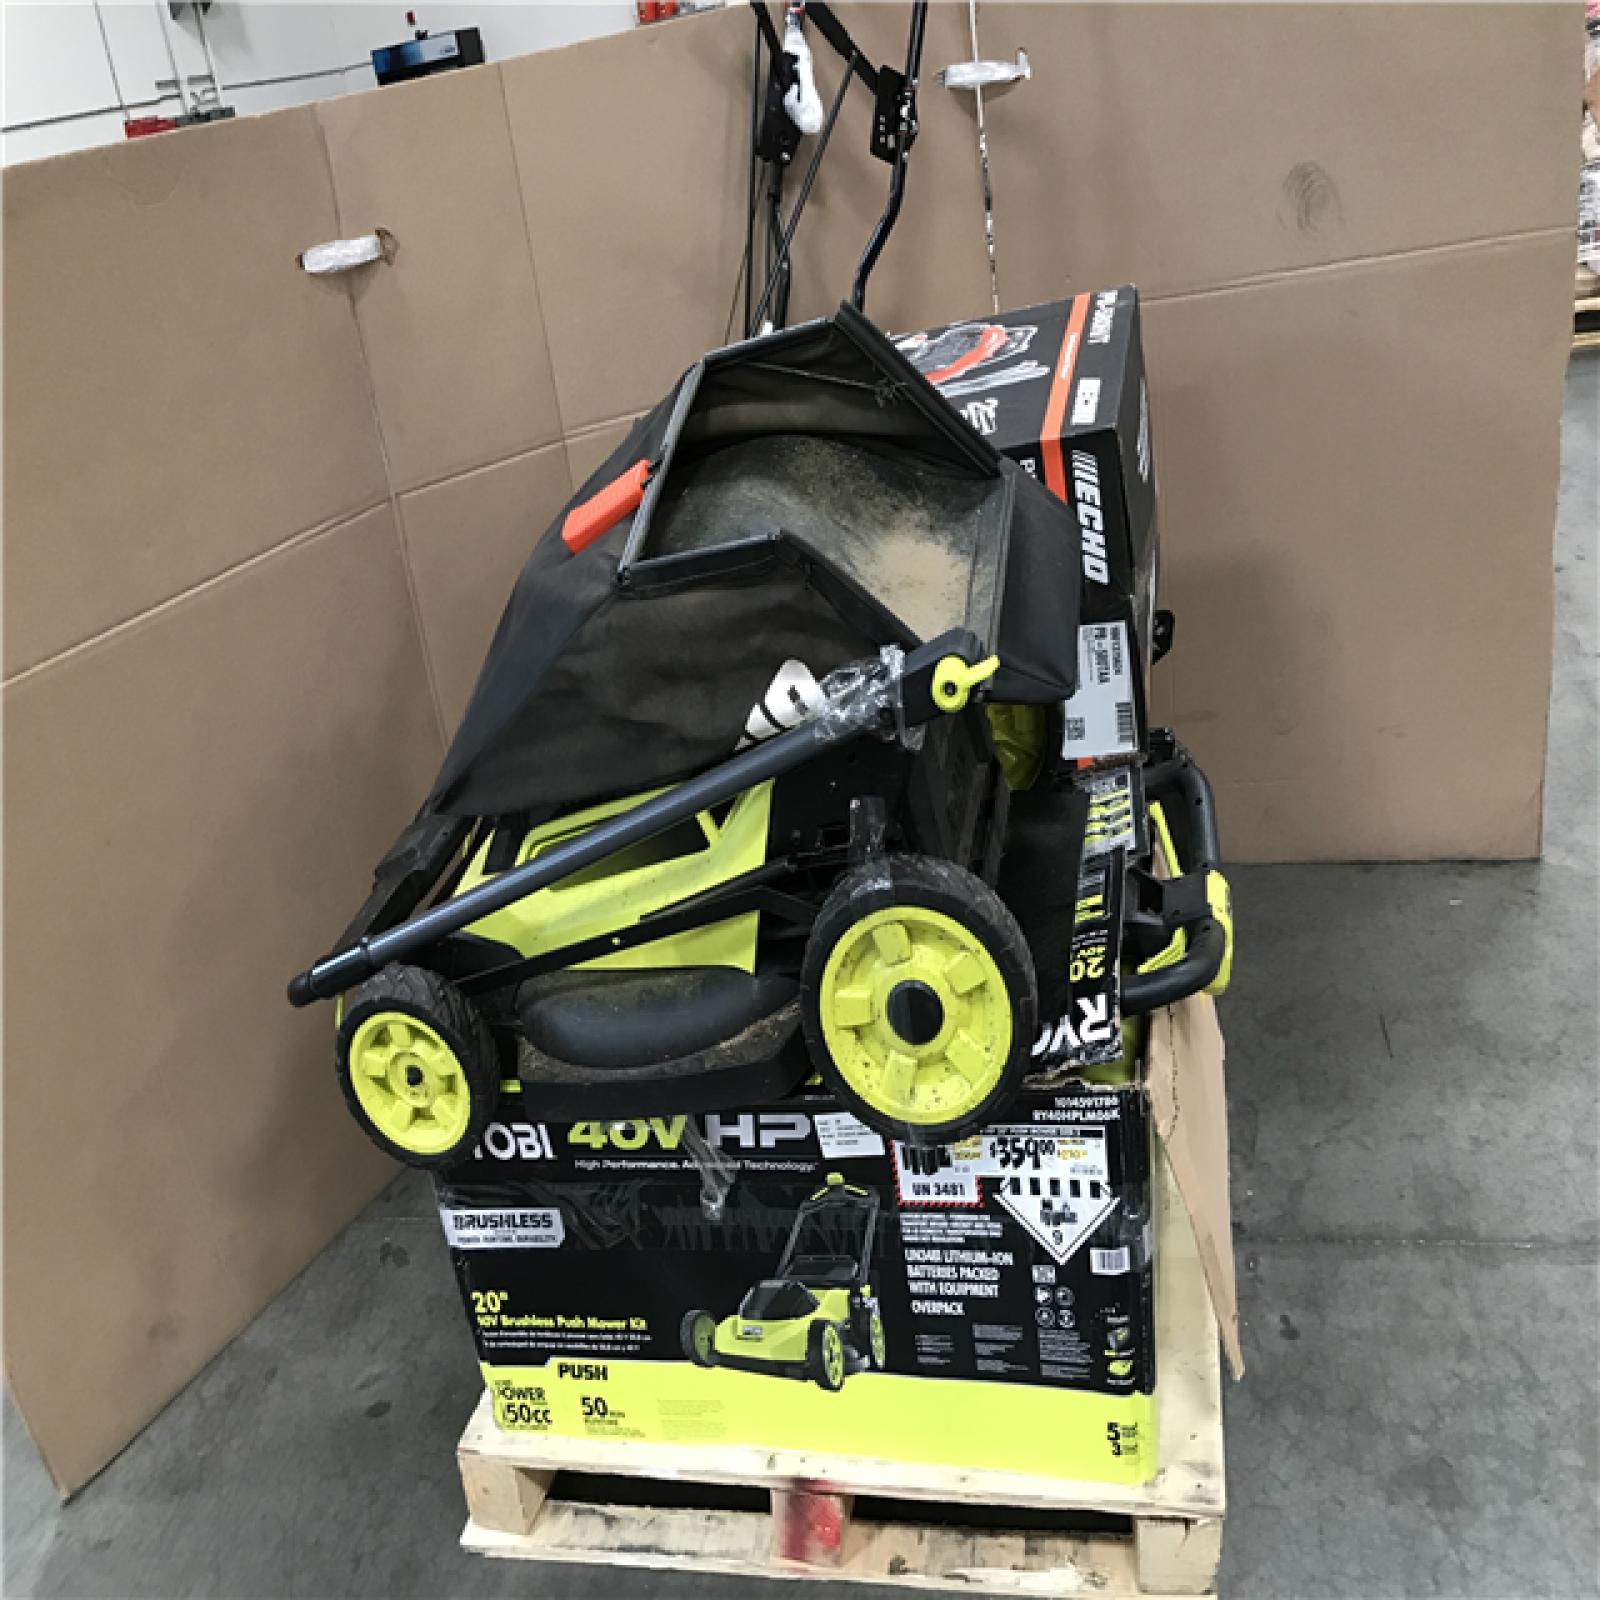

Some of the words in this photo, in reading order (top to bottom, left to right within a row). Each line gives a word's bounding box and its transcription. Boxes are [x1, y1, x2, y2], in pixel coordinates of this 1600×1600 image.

[1075, 478, 1110, 585] ECHO
[567, 1115, 688, 1149] 40V
[705, 1114, 812, 1149] HP
[574, 1159, 600, 1171] High
[911, 1182, 931, 1196] UN
[454, 1213, 554, 1230] BRUSHLESS
[940, 1281, 999, 1298] EQUIPMENT
[910, 1300, 965, 1316] OVERPACK
[501, 1314, 555, 1329] Brushless
[557, 1315, 585, 1329] Push
[587, 1317, 628, 1331] Mower
[558, 1362, 609, 1381] PUSH
[581, 1396, 609, 1418] 50
[1107, 1422, 1120, 1441] 5
